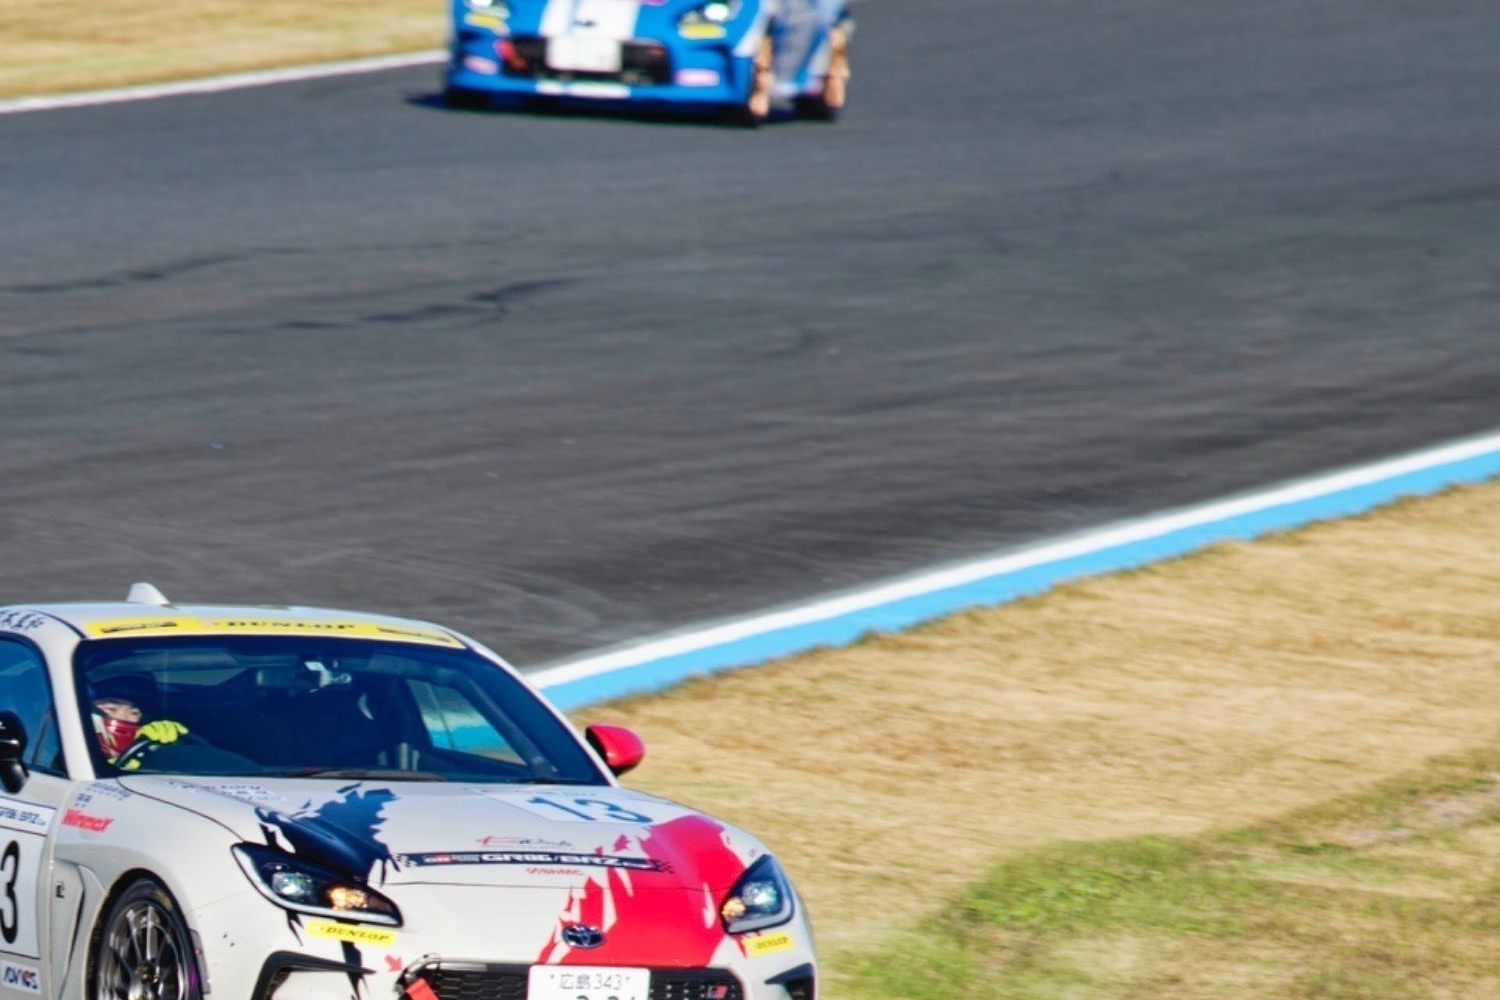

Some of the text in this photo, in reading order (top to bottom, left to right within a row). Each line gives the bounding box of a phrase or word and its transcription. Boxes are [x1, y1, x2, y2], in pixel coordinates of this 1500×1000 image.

[526, 797, 653, 824] 13
[325, 926, 390, 941] DUNLOP
[559, 973, 622, 990] 広島 343
